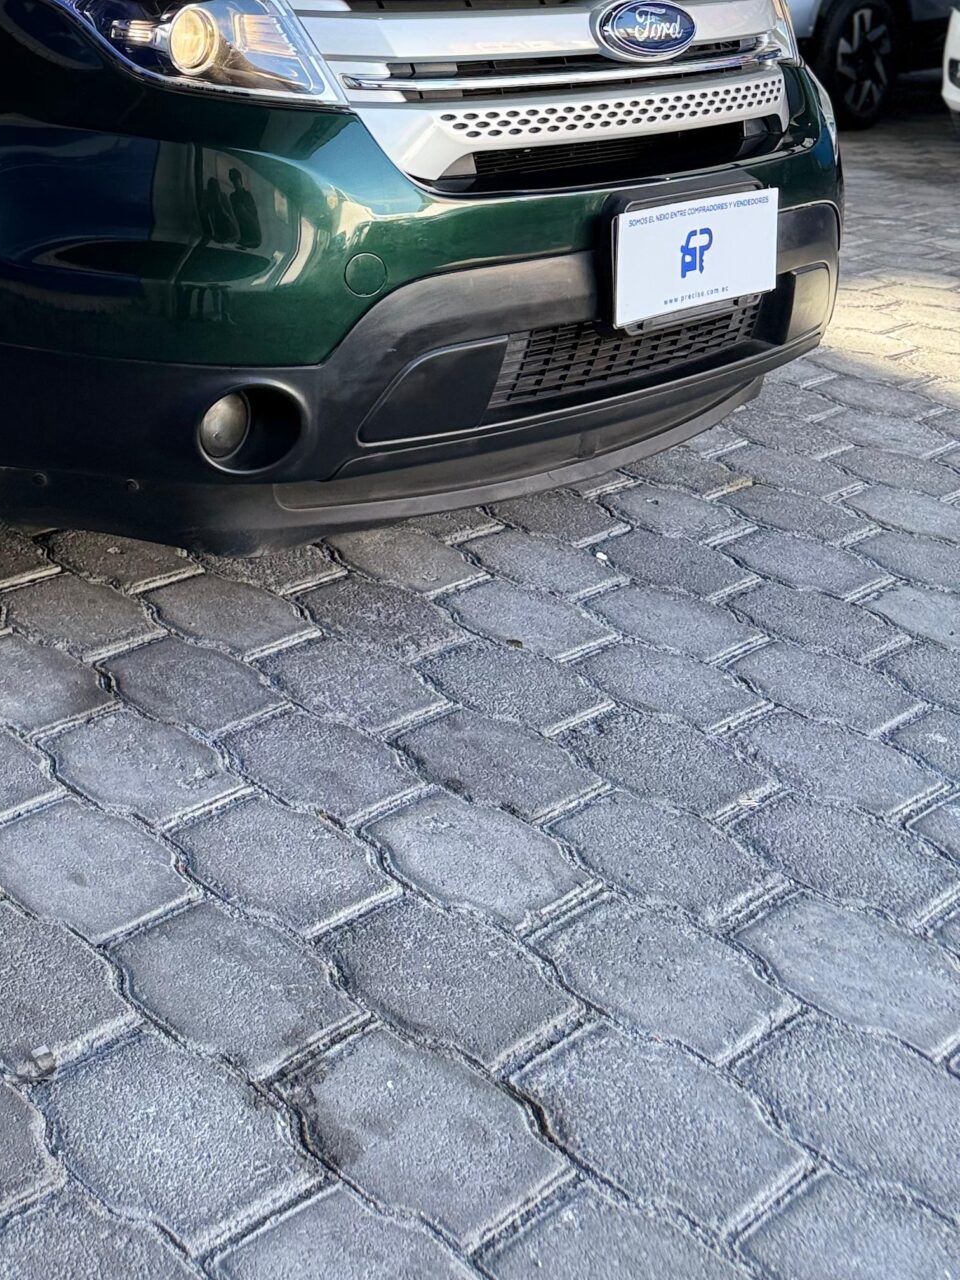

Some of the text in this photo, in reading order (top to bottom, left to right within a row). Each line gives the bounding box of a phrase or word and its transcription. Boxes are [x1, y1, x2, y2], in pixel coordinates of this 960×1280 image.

[634, 5, 684, 42] Ford
[628, 215, 649, 228] SOMOS
[648, 214, 656, 224] EL
[655, 211, 670, 223] NEXO
[670, 209, 688, 220] ENTRE
[687, 201, 729, 216] COMPRADORES
[733, 195, 770, 208] VENDEDORES
